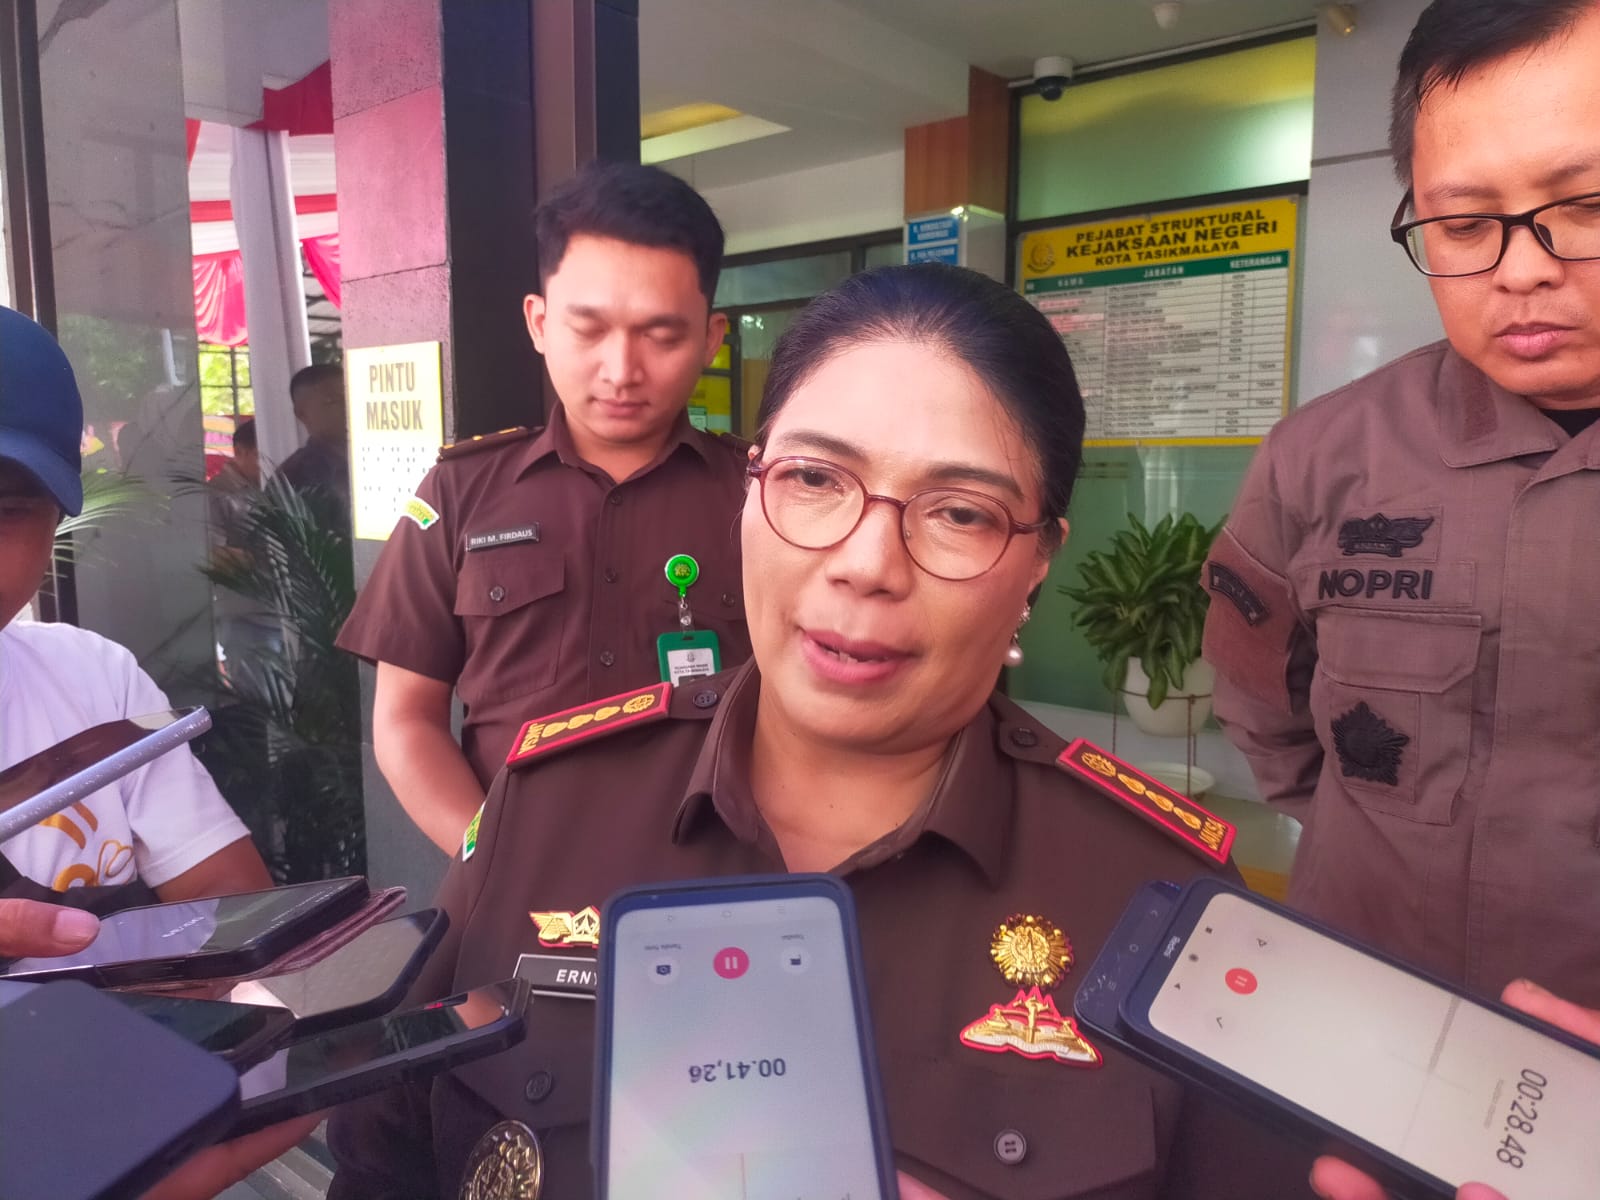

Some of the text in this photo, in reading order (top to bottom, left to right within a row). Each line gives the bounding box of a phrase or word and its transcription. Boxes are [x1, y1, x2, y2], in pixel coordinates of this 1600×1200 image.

[1066, 220, 1278, 258] KEJAKSAAN NEGERI
[1076, 209, 1265, 243] PEJABAT STRUKTURAL
[1095, 240, 1240, 266] KOTA TASIKMALAYA
[369, 361, 416, 393] PINTU
[366, 400, 424, 431] MASUK
[487, 534, 499, 543] M.
[500, 528, 533, 541] FIRDAUS
[1318, 569, 1434, 600] NOPRI
[1496, 1068, 1548, 1169] 00:28.48
